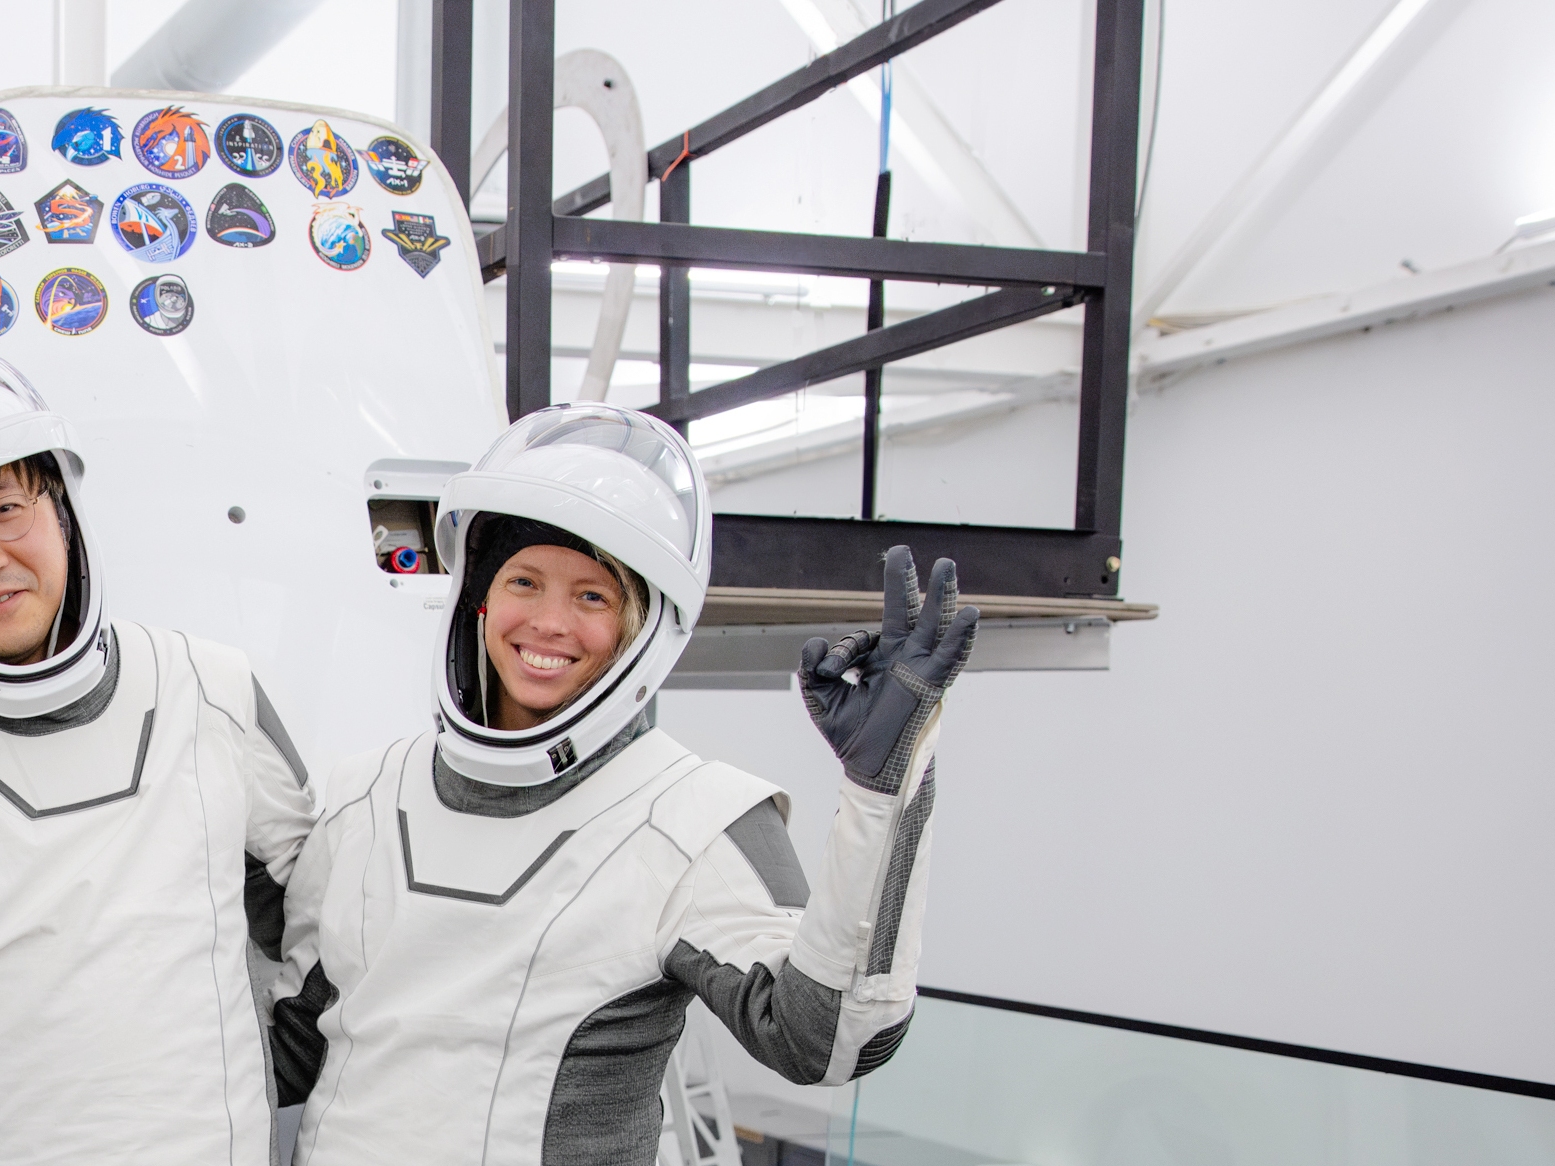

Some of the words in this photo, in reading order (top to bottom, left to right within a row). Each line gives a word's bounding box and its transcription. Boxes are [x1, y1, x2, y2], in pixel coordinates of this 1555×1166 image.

[101, 126, 112, 151] 1
[291, 132, 304, 148] CHARI
[174, 155, 186, 170] 2
[111, 201, 121, 224] BOWEN
[123, 184, 150, 198] HOBURG
